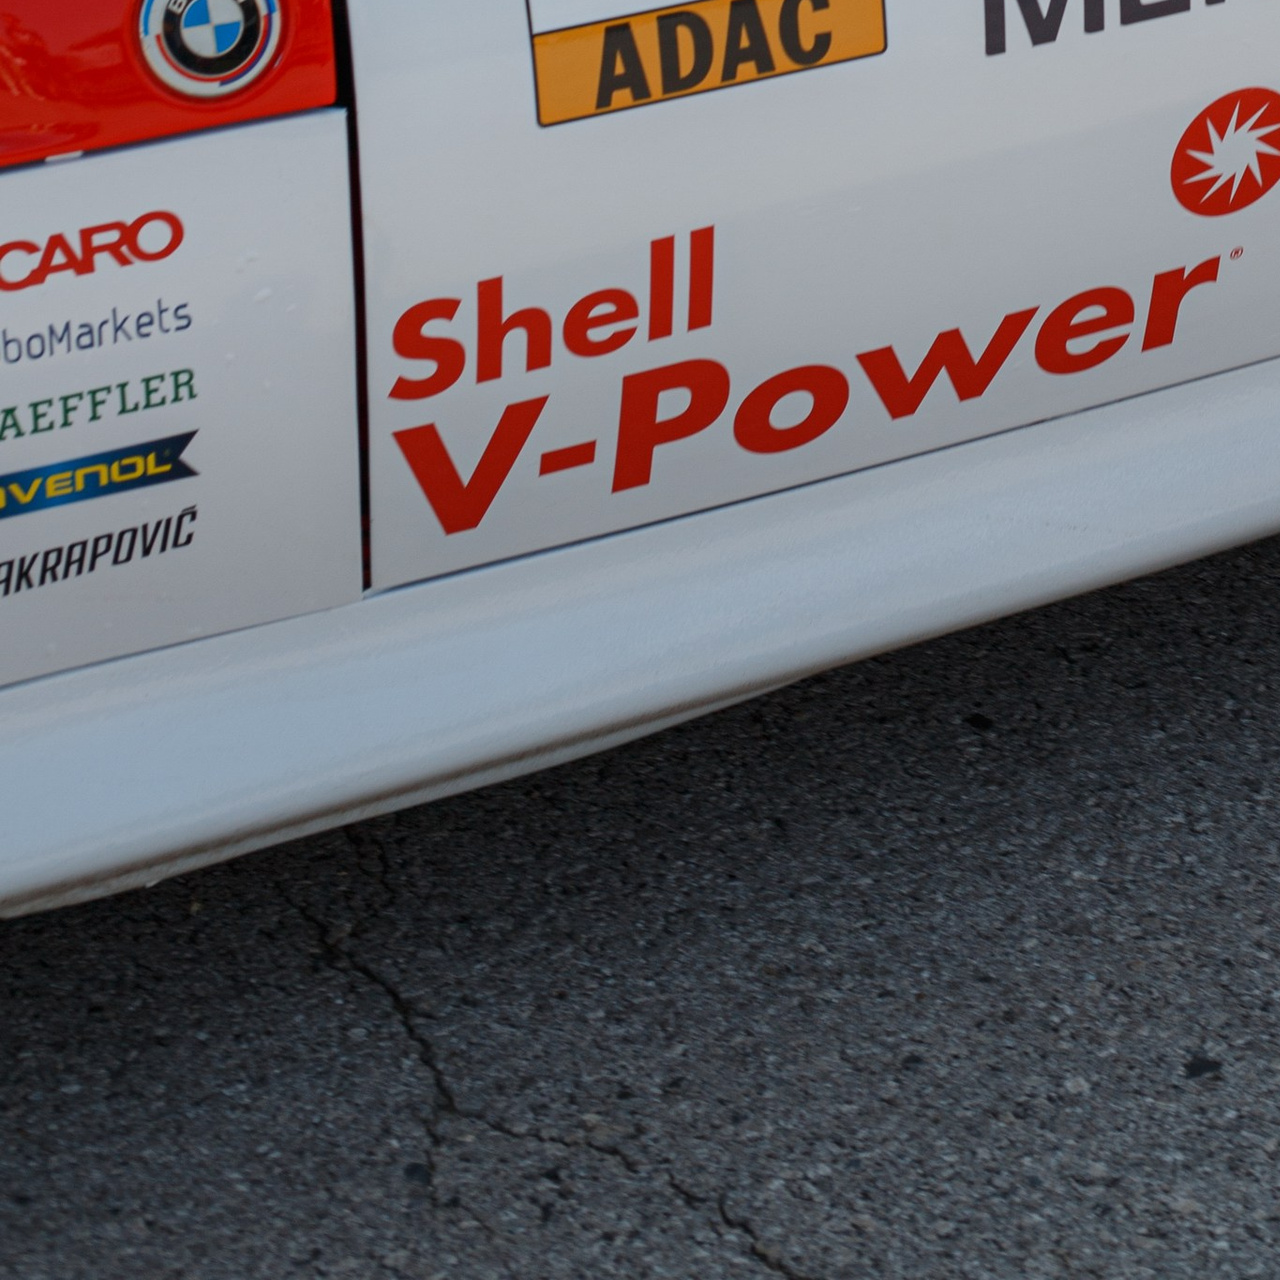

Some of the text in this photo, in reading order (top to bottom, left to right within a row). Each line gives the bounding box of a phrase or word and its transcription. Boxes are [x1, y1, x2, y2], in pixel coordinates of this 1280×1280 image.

[0, 210, 184, 292] CARO
[387, 225, 715, 400] Shell
[0, 368, 198, 440] AEFFLER
[391, 254, 1221, 535] V-Power
